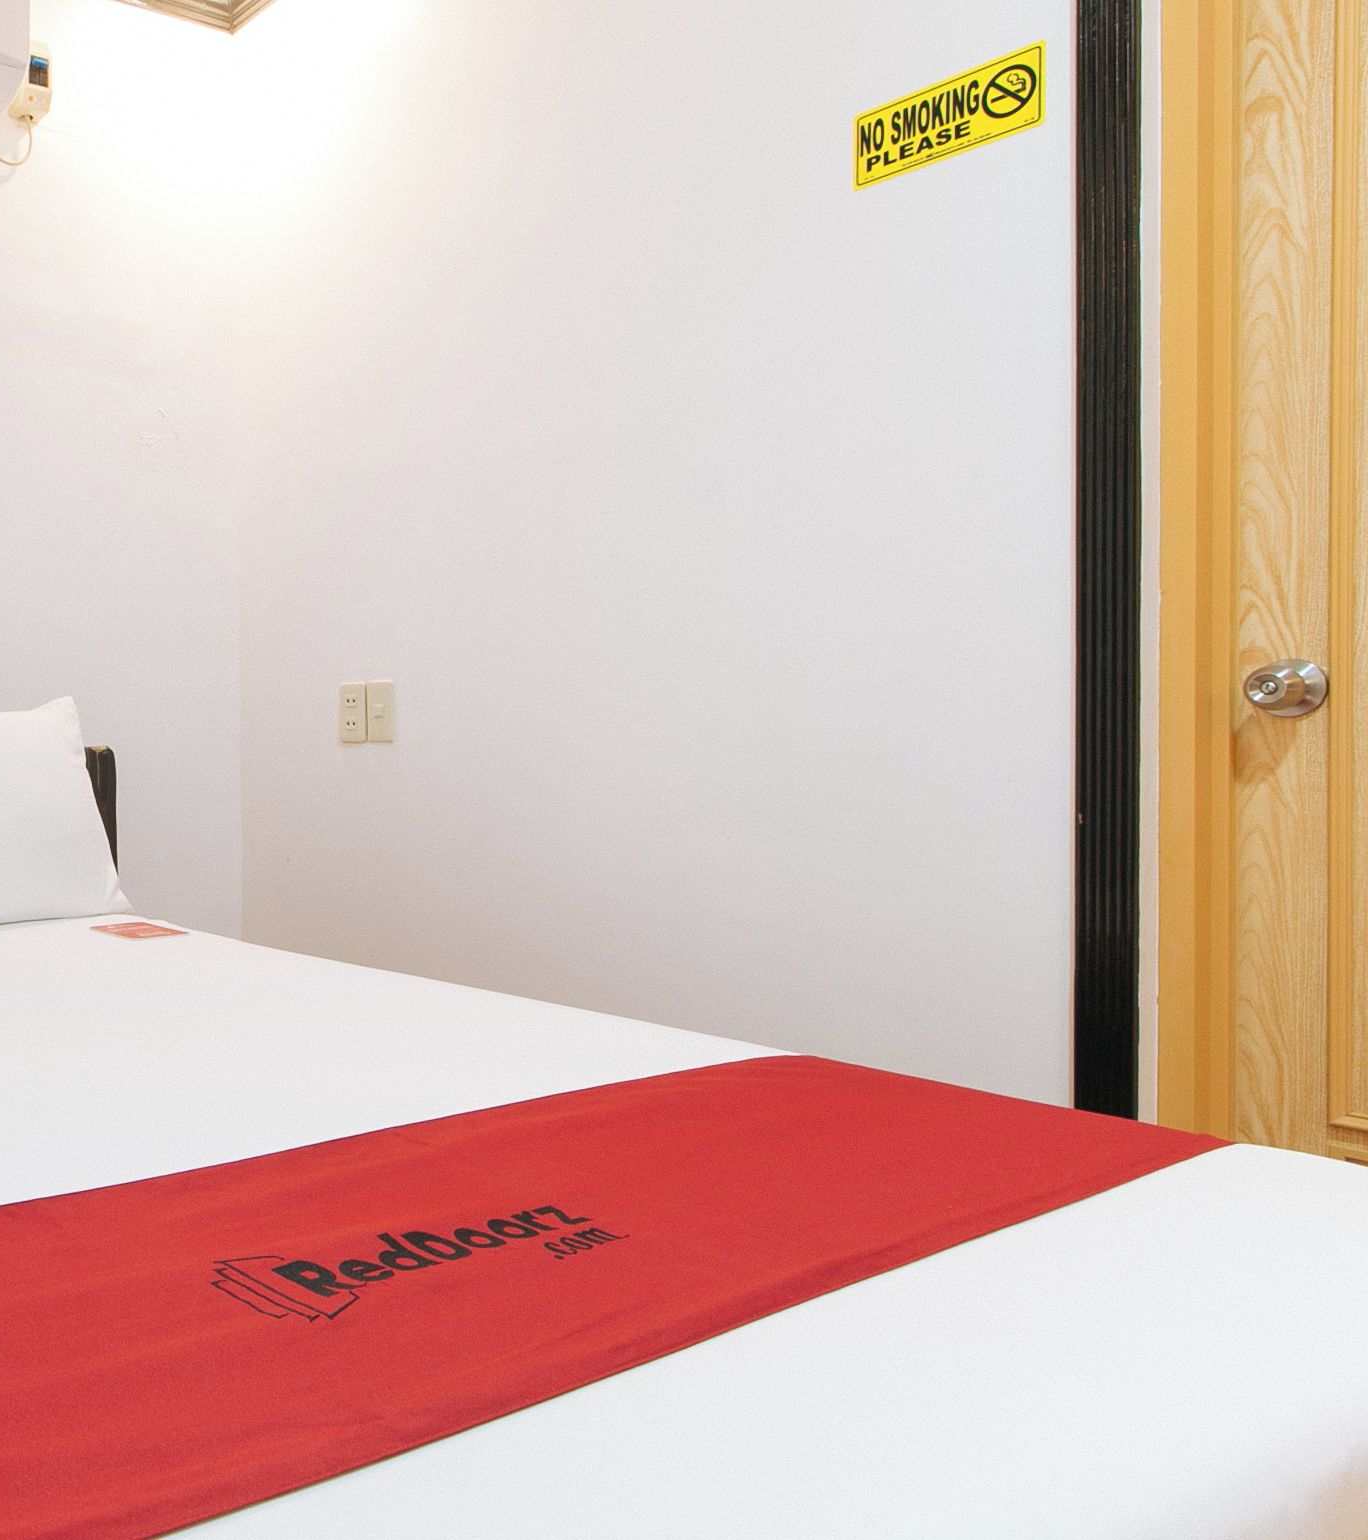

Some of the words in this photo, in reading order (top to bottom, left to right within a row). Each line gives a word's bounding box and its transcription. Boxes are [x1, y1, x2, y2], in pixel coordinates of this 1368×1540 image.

[860, 117, 883, 157] NO
[891, 79, 980, 145] SMOKING
[865, 119, 971, 173] PLEASE
[272, 1205, 593, 1298] RedDoorz
